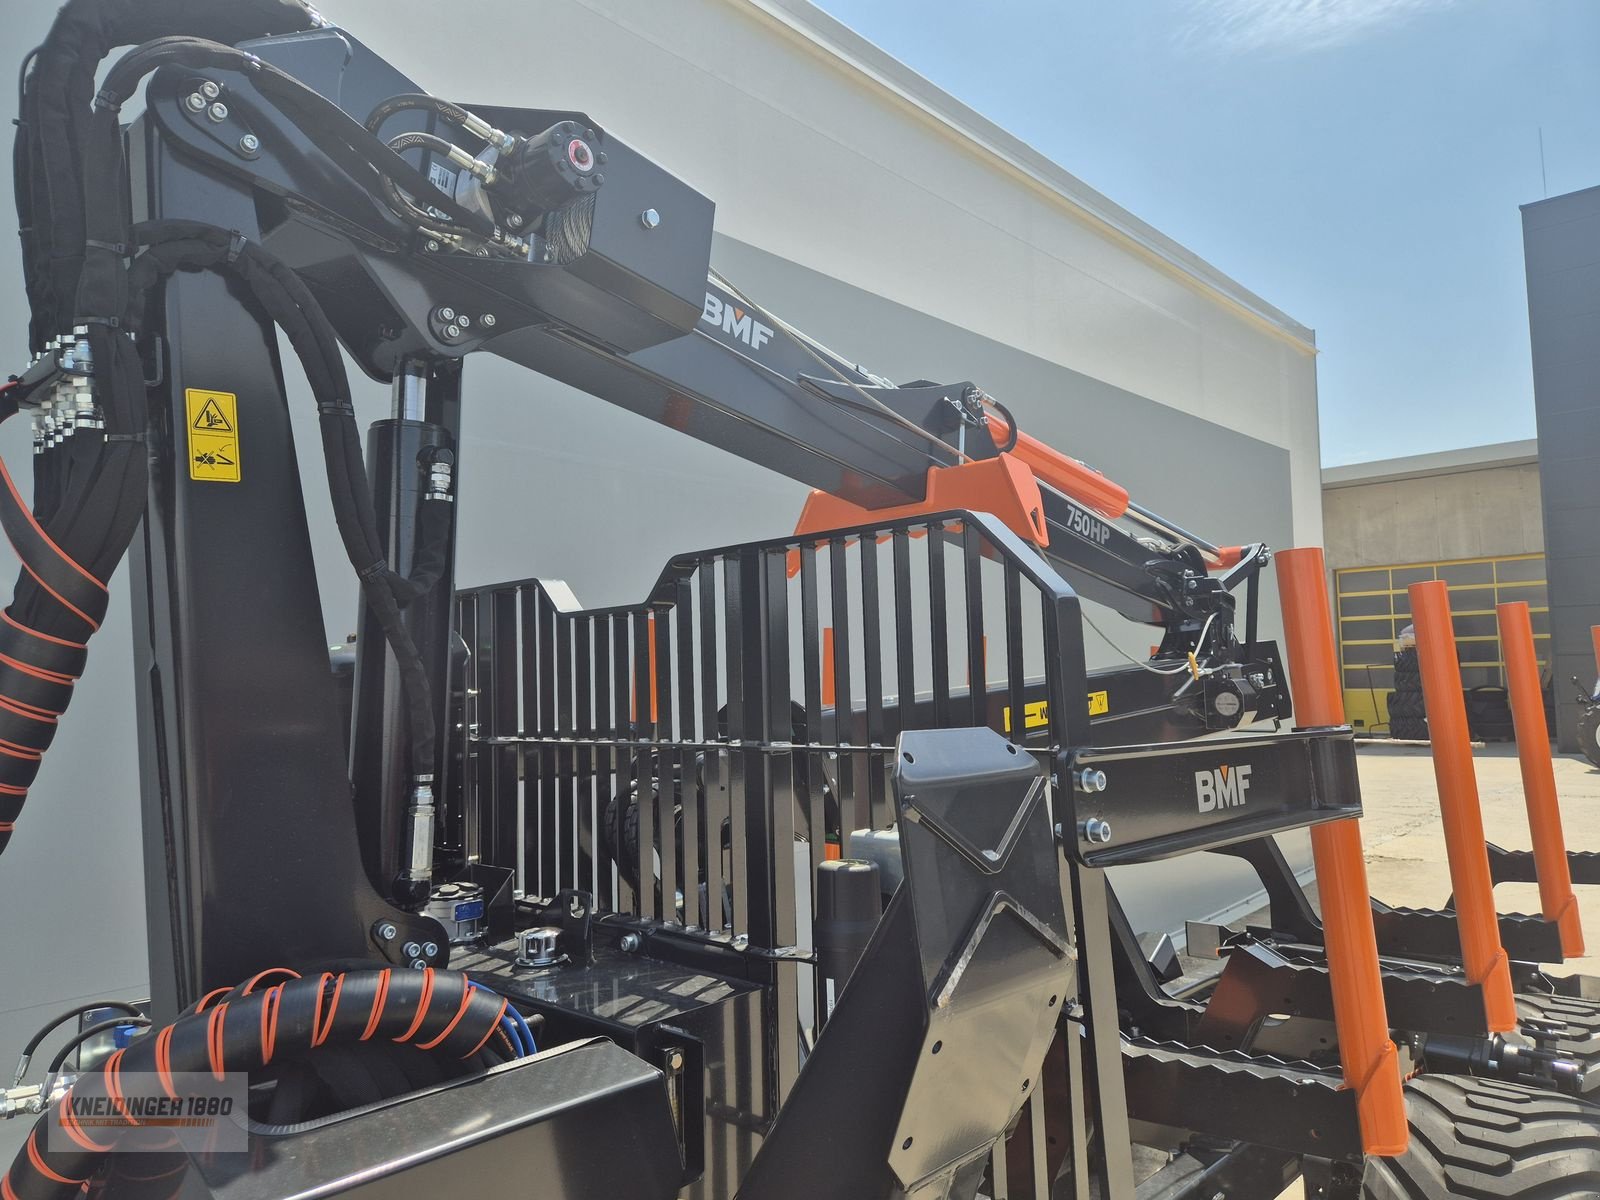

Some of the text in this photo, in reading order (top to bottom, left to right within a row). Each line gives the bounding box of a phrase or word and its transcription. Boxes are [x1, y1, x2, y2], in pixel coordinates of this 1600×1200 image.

[701, 291, 774, 350] BMF
[1067, 504, 1110, 545] 750HP
[1195, 764, 1252, 813] BMF
